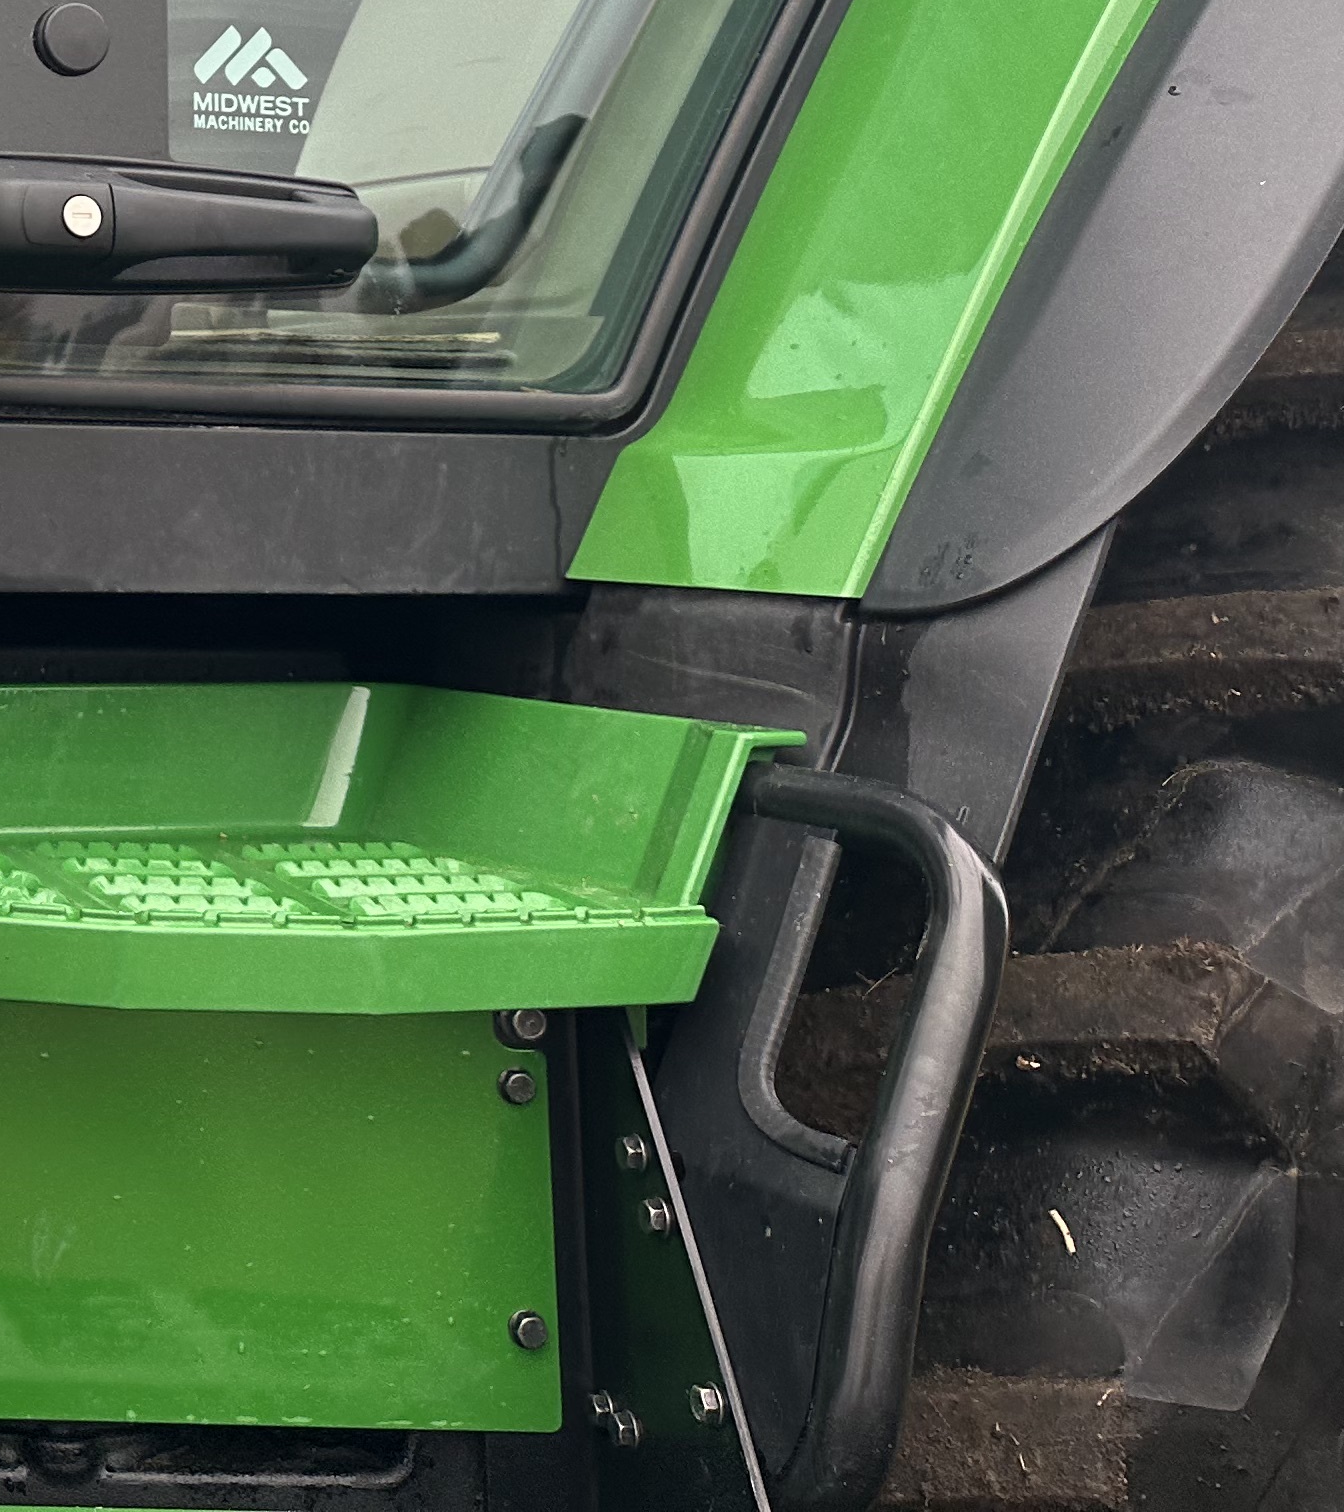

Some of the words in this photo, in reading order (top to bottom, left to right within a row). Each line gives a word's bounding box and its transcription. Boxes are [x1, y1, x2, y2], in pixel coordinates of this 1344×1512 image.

[193, 91, 310, 117] MIDWEST
[193, 114, 284, 133] MACHINERY
[288, 119, 310, 135] CO
